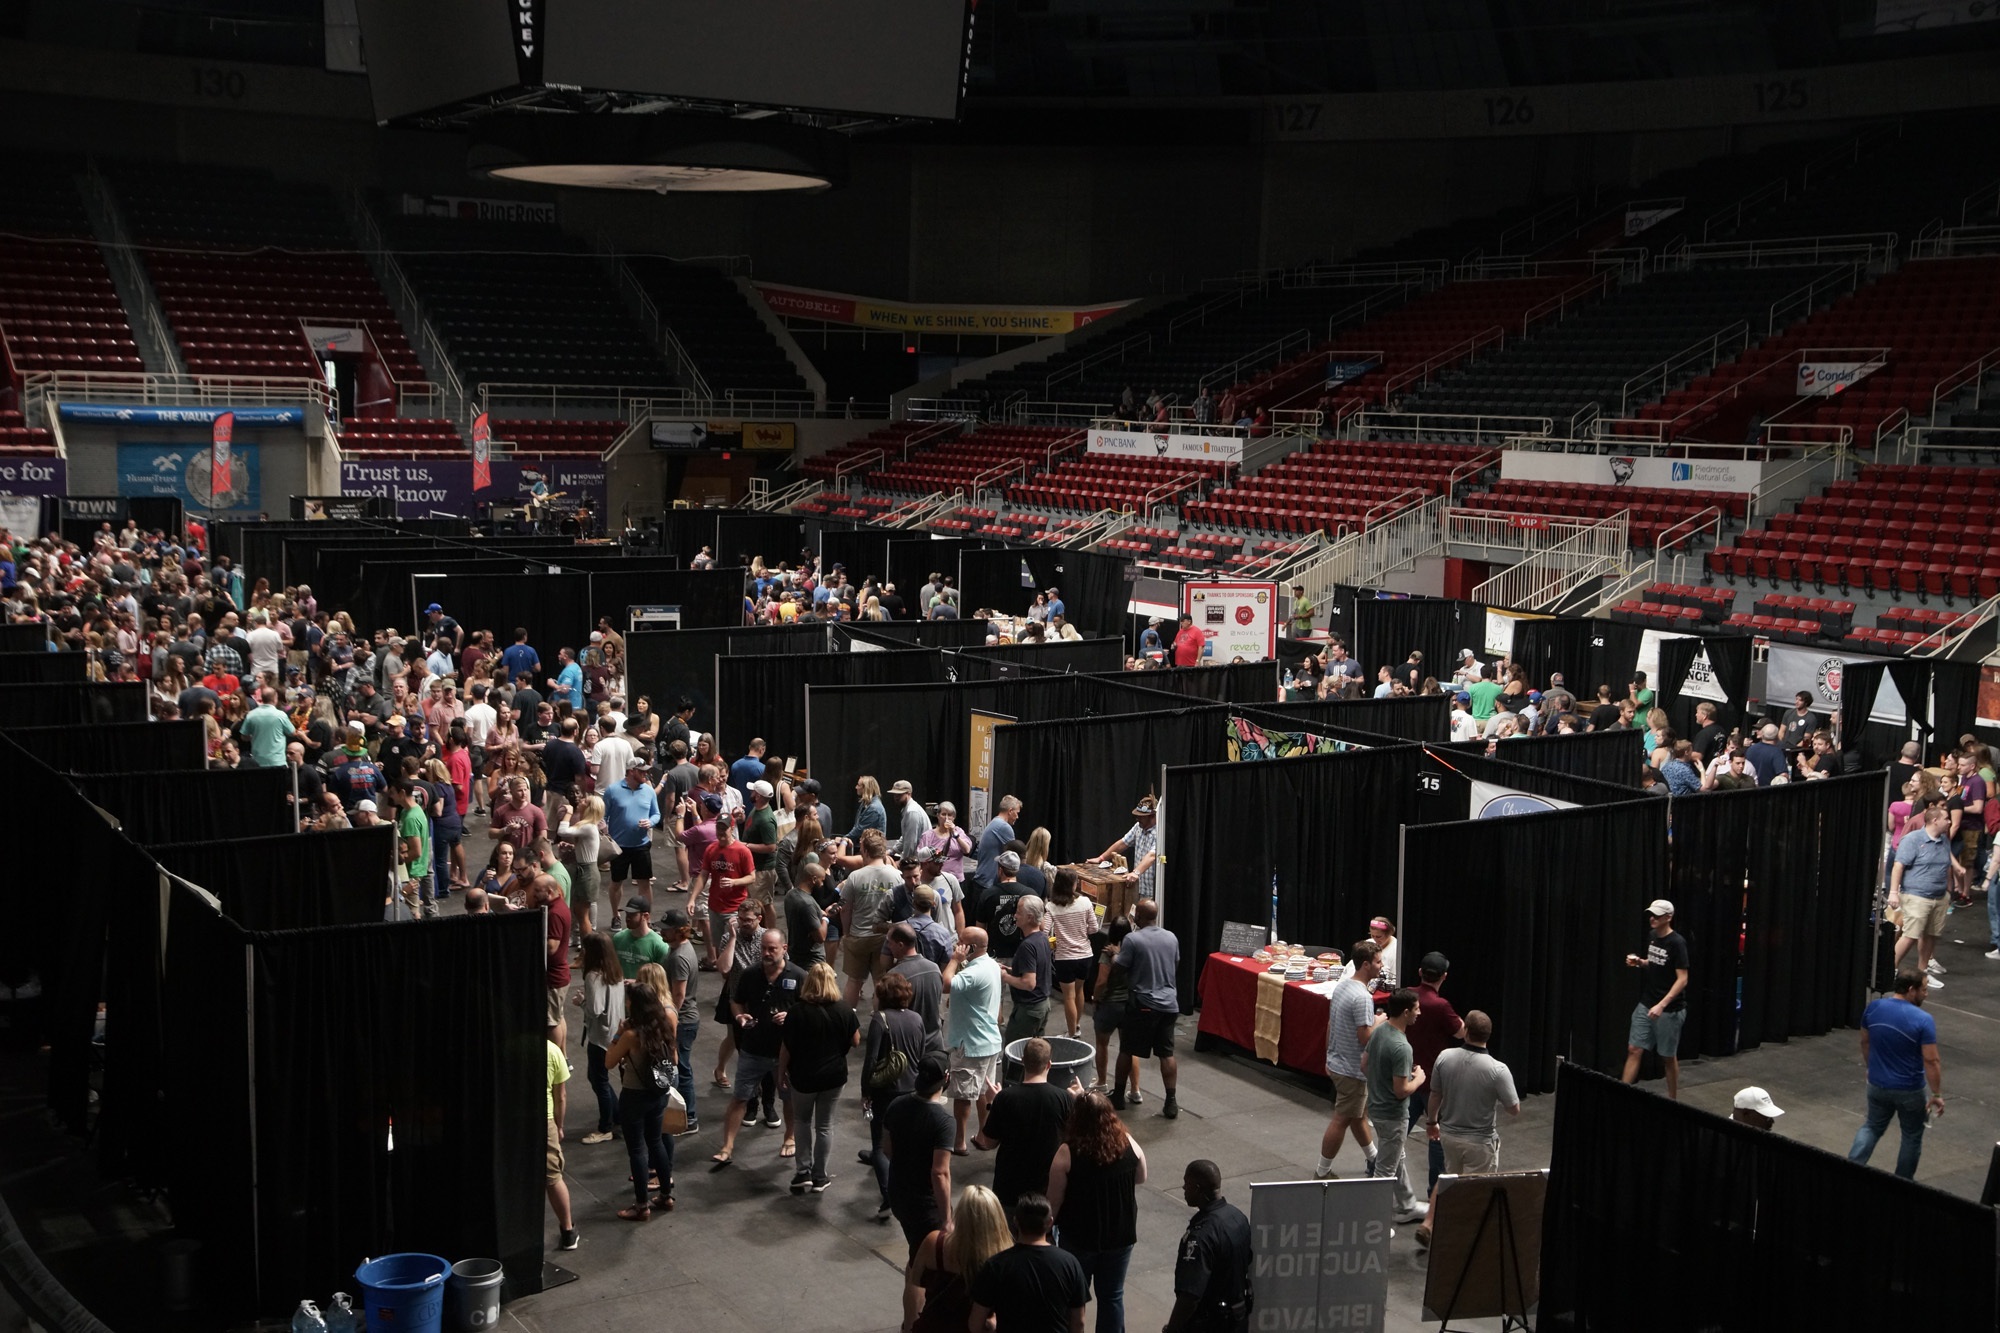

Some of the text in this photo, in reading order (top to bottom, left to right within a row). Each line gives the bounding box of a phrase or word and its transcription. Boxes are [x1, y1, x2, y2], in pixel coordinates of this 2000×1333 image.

[191, 67, 246, 100] 130
[1753, 79, 1808, 112] 125
[1275, 103, 1322, 131] 127
[1484, 96, 1534, 126] 126
[769, 295, 840, 314] AUTOBELL
[870, 310, 1054, 328] WHEN WE SHINE, YOU SHINE.
[1817, 369, 1856, 382] Conder
[156, 411, 216, 423] THE VAULT
[1118, 439, 1137, 449] BANK
[1182, 443, 1237, 454] FAMOUS TOASTERY
[20, 461, 55, 481] for
[343, 463, 433, 484] Trust us,
[1695, 464, 1730, 474] Piedmont
[1695, 473, 1736, 482] Natural Gas
[153, 485, 177, 493] Bank
[392, 484, 448, 502] know
[67, 500, 117, 513] TOWN
[1520, 518, 1538, 526] VIP
[1332, 607, 1341, 615] 44
[1230, 642, 1260, 651] reverb
[1592, 638, 1604, 647] 42
[1421, 777, 1440, 791] 15
